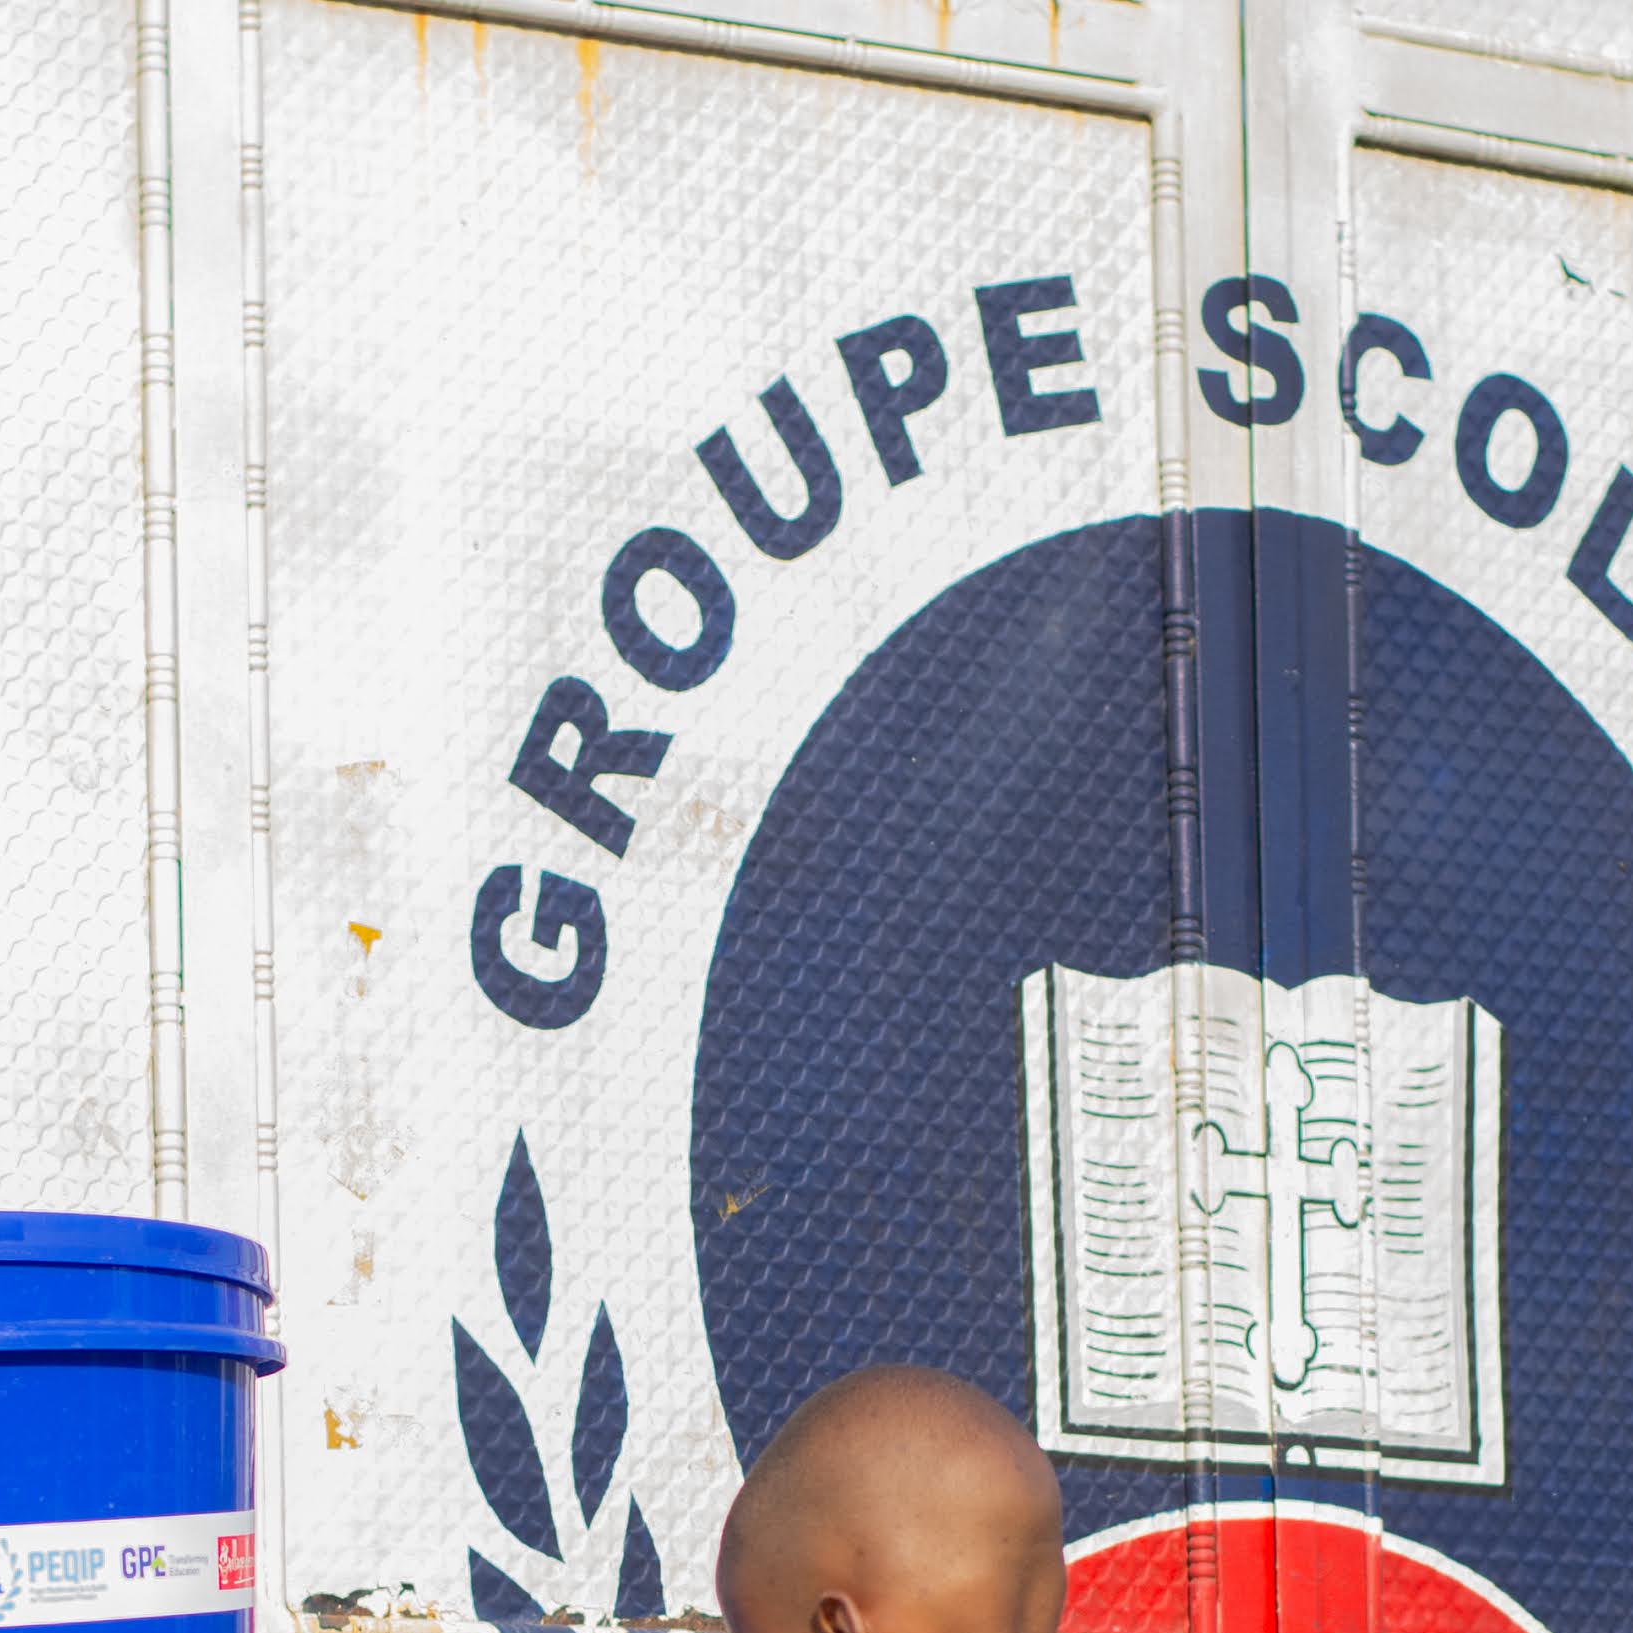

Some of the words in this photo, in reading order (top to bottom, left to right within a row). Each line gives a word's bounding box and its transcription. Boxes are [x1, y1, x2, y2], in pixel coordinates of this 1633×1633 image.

[470, 273, 1102, 1031] GROUPE
[29, 1549, 104, 1583] PEQIP
[121, 1545, 166, 1579] GPE
